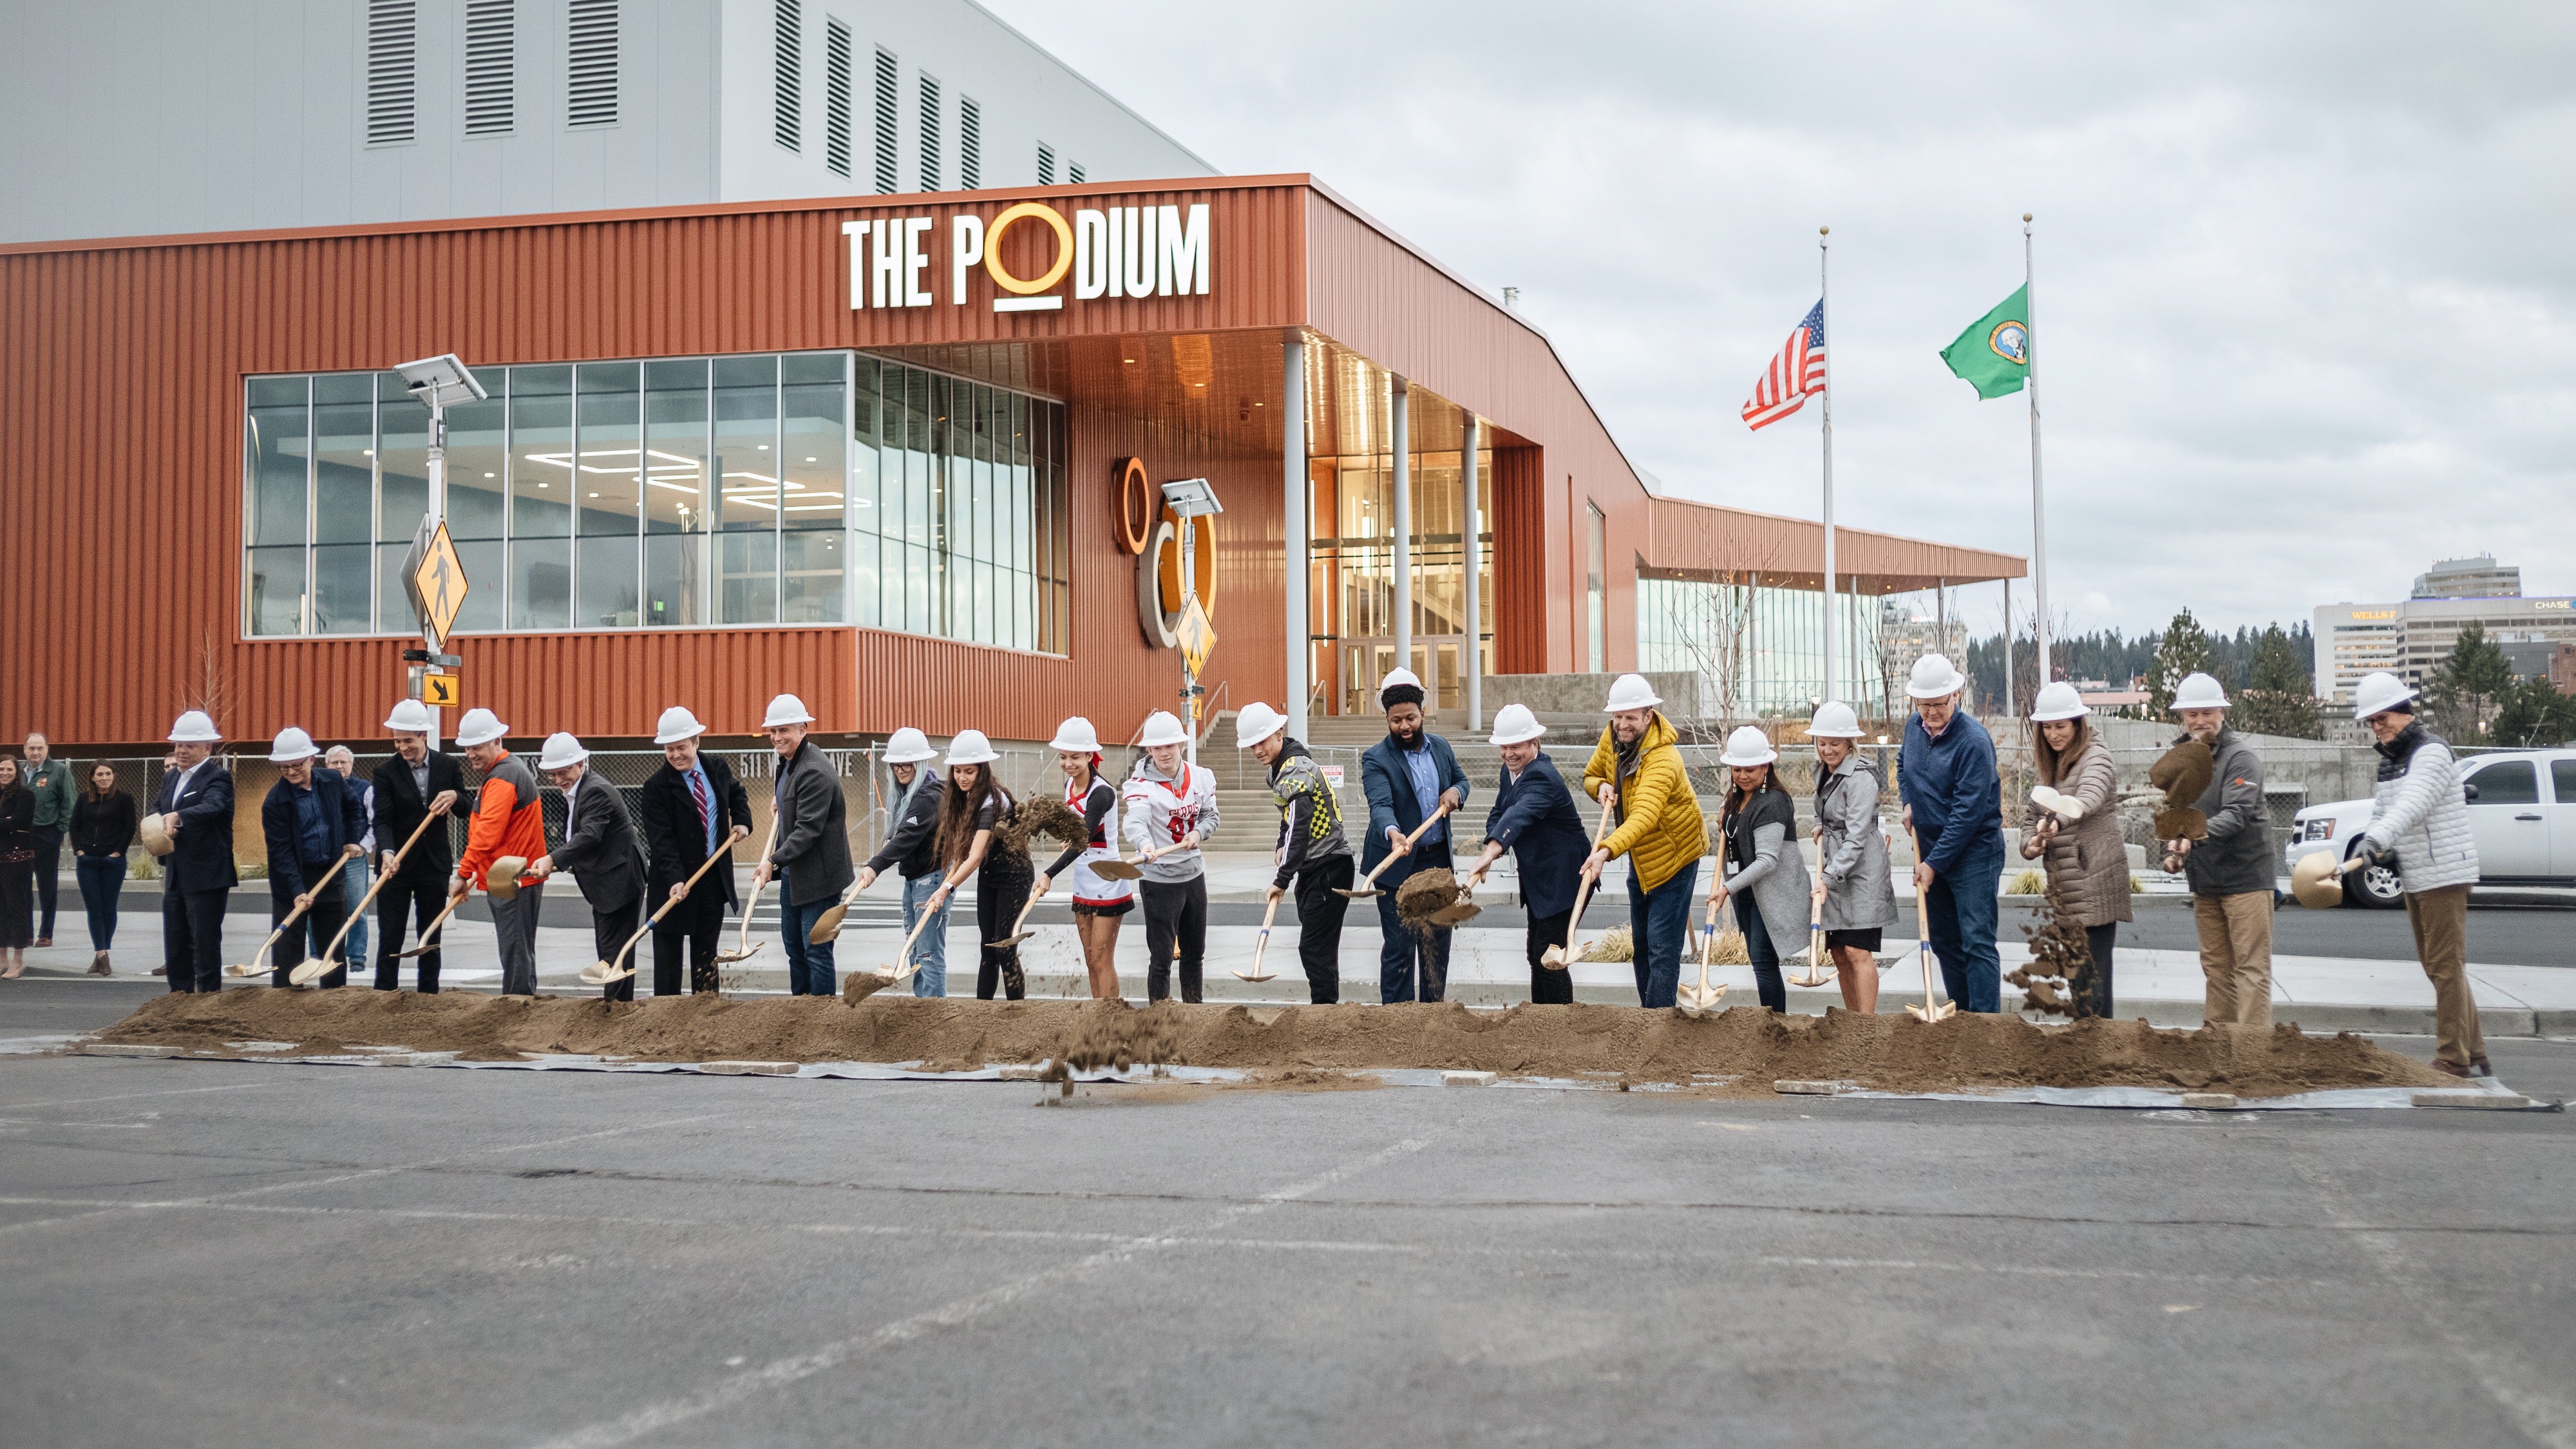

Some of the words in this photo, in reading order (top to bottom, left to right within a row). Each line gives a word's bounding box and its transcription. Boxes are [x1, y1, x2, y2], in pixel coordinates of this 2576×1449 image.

[842, 216, 933, 310] THE
[953, 202, 1209, 305] PODIUM
[2535, 601, 2570, 609] CHASE
[2351, 611, 2388, 620] WELLS
[741, 753, 761, 778] 511
[829, 752, 853, 777] AVE
